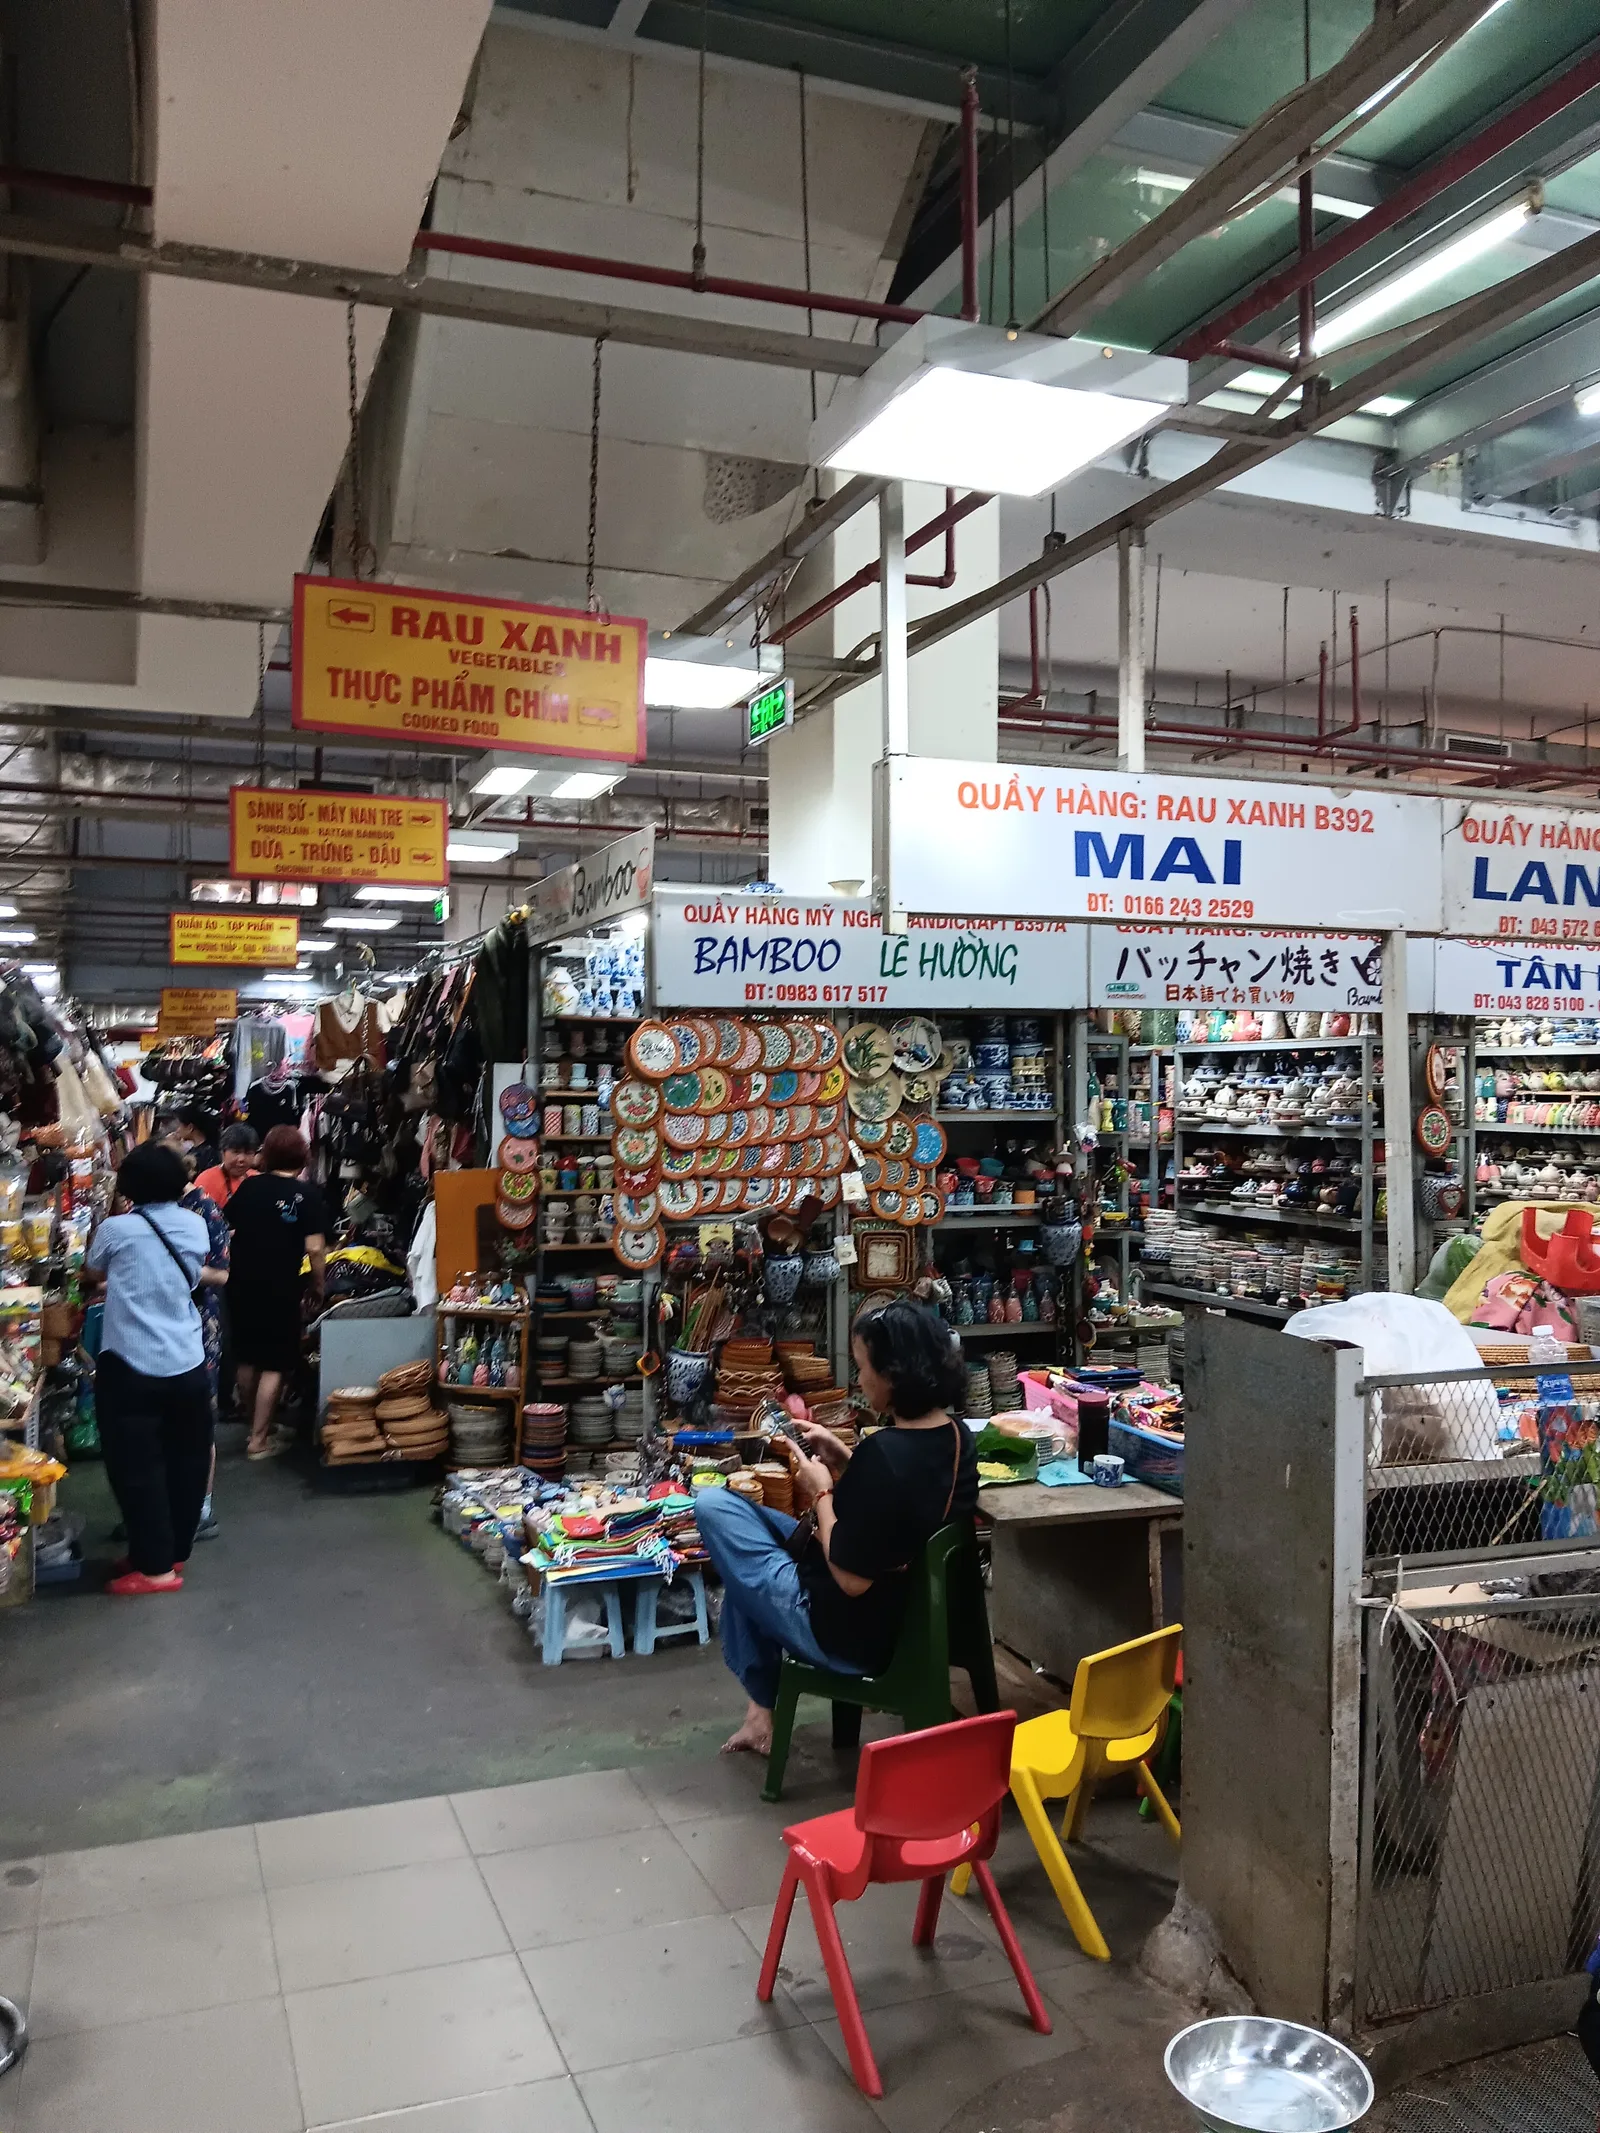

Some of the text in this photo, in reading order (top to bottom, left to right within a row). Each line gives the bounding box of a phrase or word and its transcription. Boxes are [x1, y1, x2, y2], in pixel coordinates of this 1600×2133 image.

[391, 606, 622, 664] RAU XANH
[449, 649, 566, 677] VEGETABLES
[326, 666, 569, 723] THỰC PHẨM CHÍN
[402, 712, 499, 737] COOKED FOOD
[381, 808, 403, 826] TRE
[957, 772, 1375, 833] QUẦY HÀNG: RAU XANH B392
[1074, 830, 1242, 885] MAI
[571, 852, 637, 917] Bamboo
[683, 896, 740, 924] QUẦY
[745, 902, 800, 926] HÀNG
[805, 903, 835, 926] MỸ
[843, 909, 882, 928] NGH
[906, 916, 1007, 932] ANDICRAFT
[1124, 895, 1164, 916] 0166
[1169, 897, 1202, 917] 243
[1208, 899, 1254, 919] 2529
[1530, 917, 1557, 935] 043
[1562, 919, 1589, 937] 572
[693, 930, 1019, 985] BAMBOO LÊ HƯỜNG
[1116, 940, 1340, 987] バッチャン焼き
[1496, 955, 1582, 991] TÂN
[776, 984, 818, 1002] 0983
[822, 985, 853, 1002] 617
[858, 986, 888, 1002] 517
[1165, 984, 1295, 1005] 日本語でお買い物
[1498, 995, 1522, 1010] 043
[1526, 996, 1549, 1010] 828
[1553, 997, 1585, 1011] 5100
